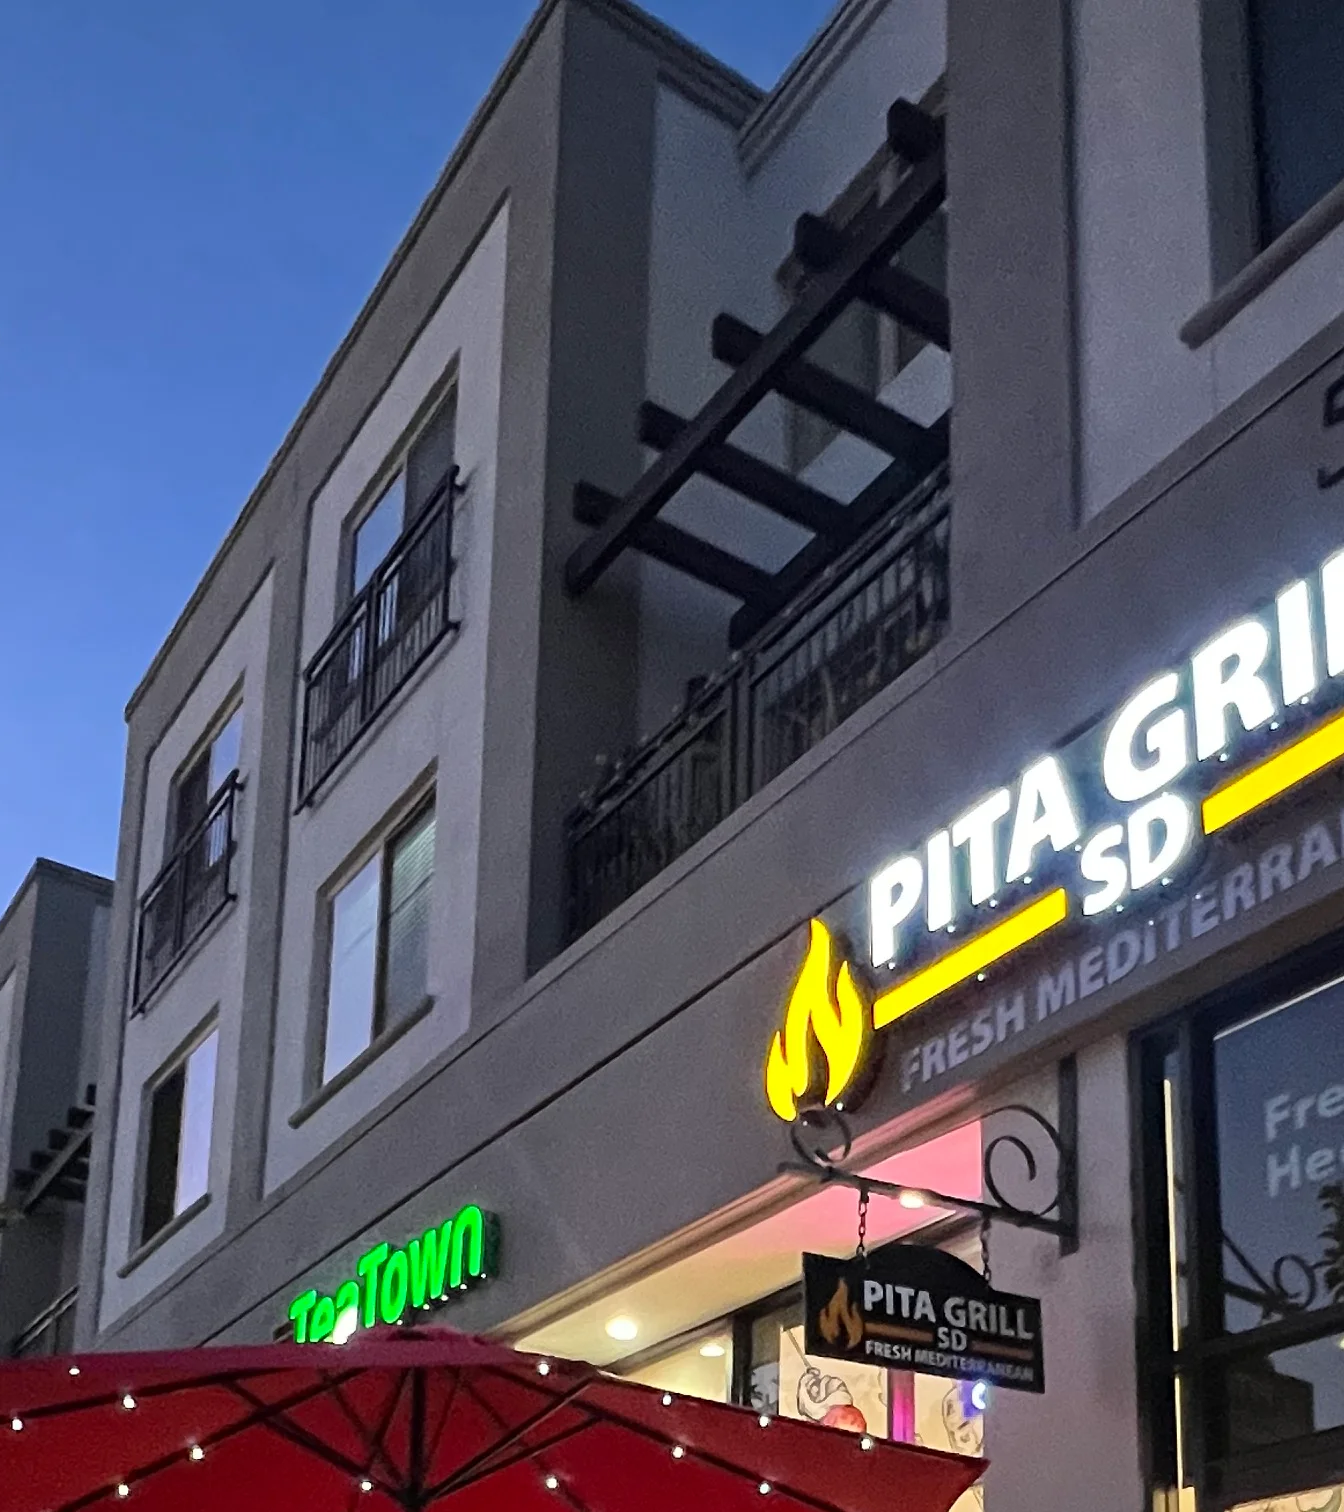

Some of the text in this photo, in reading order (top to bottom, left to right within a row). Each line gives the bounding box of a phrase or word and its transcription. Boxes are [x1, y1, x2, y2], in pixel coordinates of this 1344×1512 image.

[868, 755, 1084, 967] PITA
[1080, 793, 1194, 917] SD
[902, 994, 1025, 1093] FRESH
[863, 1279, 1035, 1341] PITA GRILL
[937, 1326, 968, 1351] SD
[866, 1339, 1035, 1383] FRESH MEDITERRANEAN
